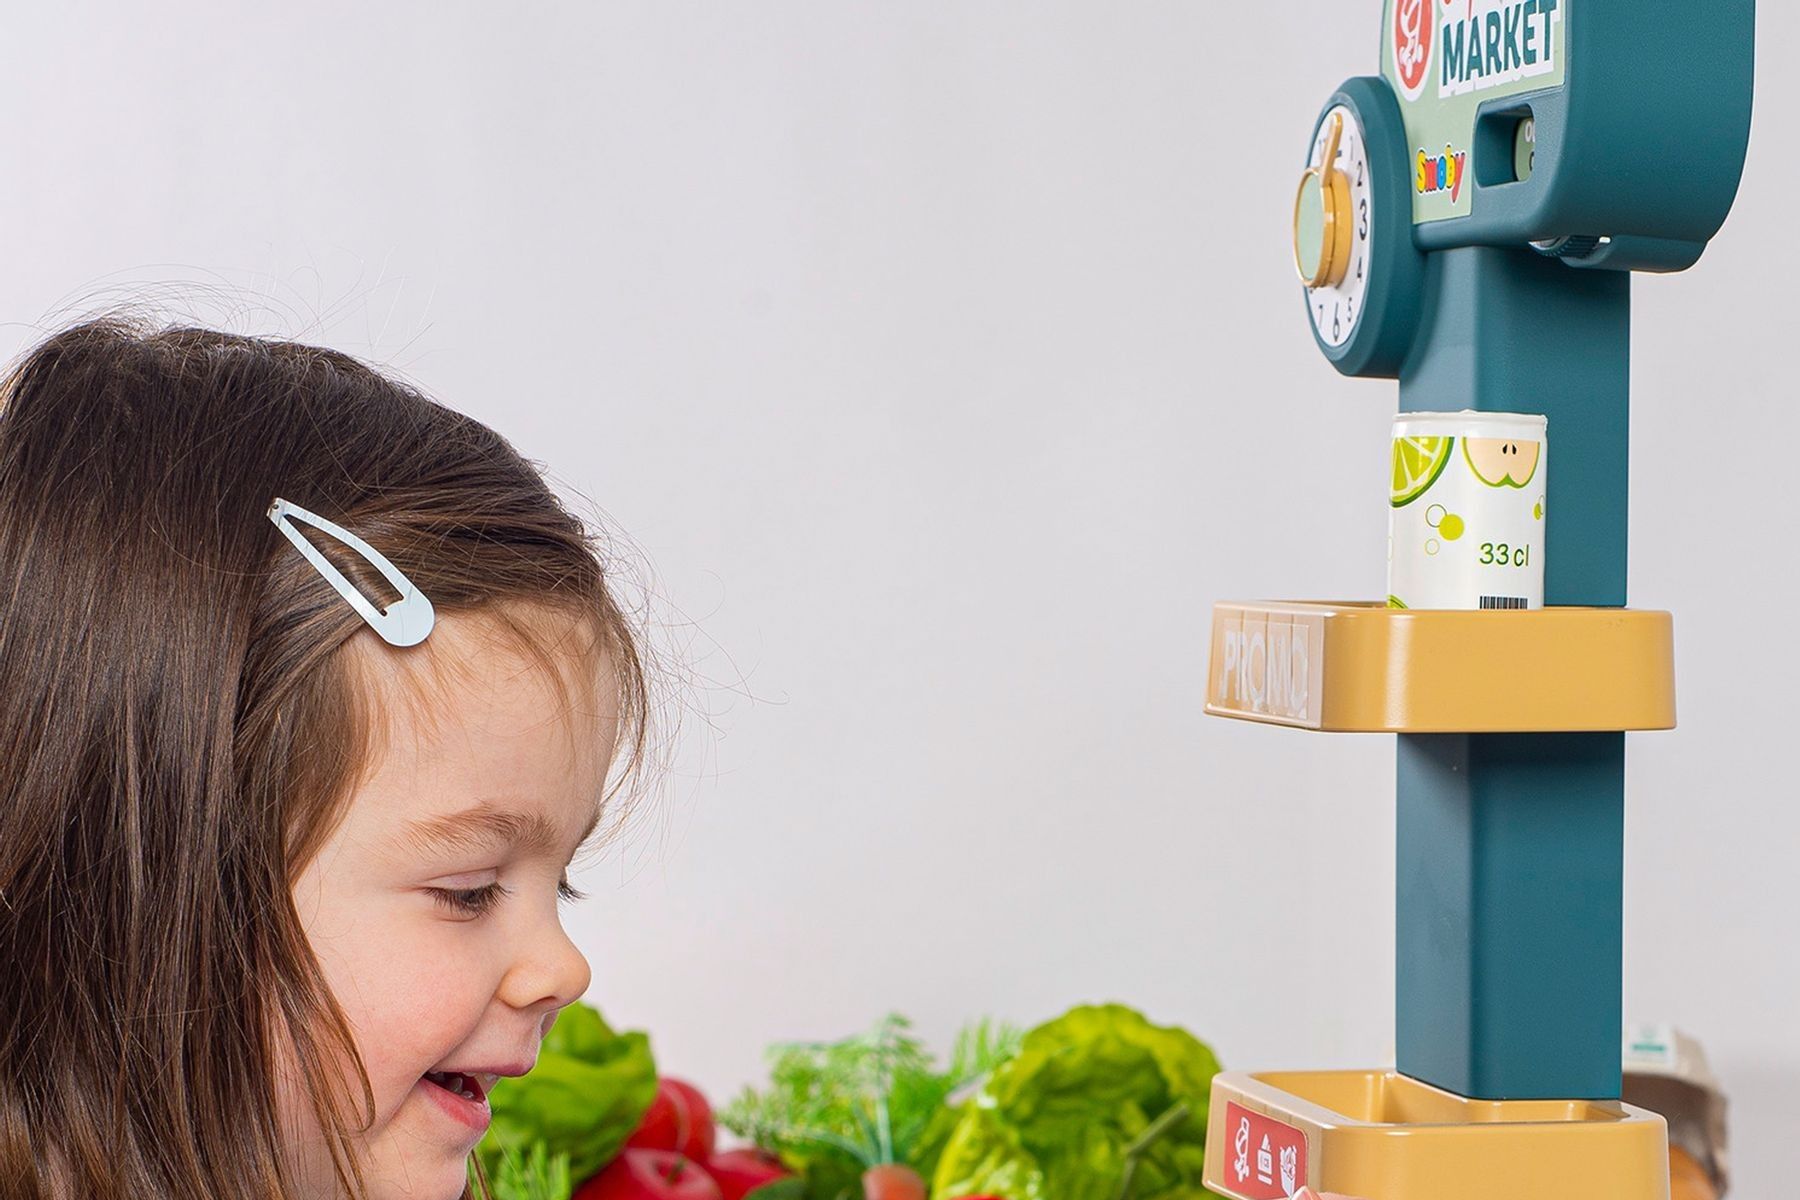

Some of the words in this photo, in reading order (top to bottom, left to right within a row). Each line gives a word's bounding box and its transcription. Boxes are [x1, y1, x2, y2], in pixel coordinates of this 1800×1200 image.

[1442, 0, 1557, 87] MARKET
[1356, 161, 1363, 187] 2
[1416, 142, 1466, 204] Smoby
[1358, 199, 1368, 241] 3
[1356, 257, 1363, 283] 4
[1332, 302, 1341, 342] 6
